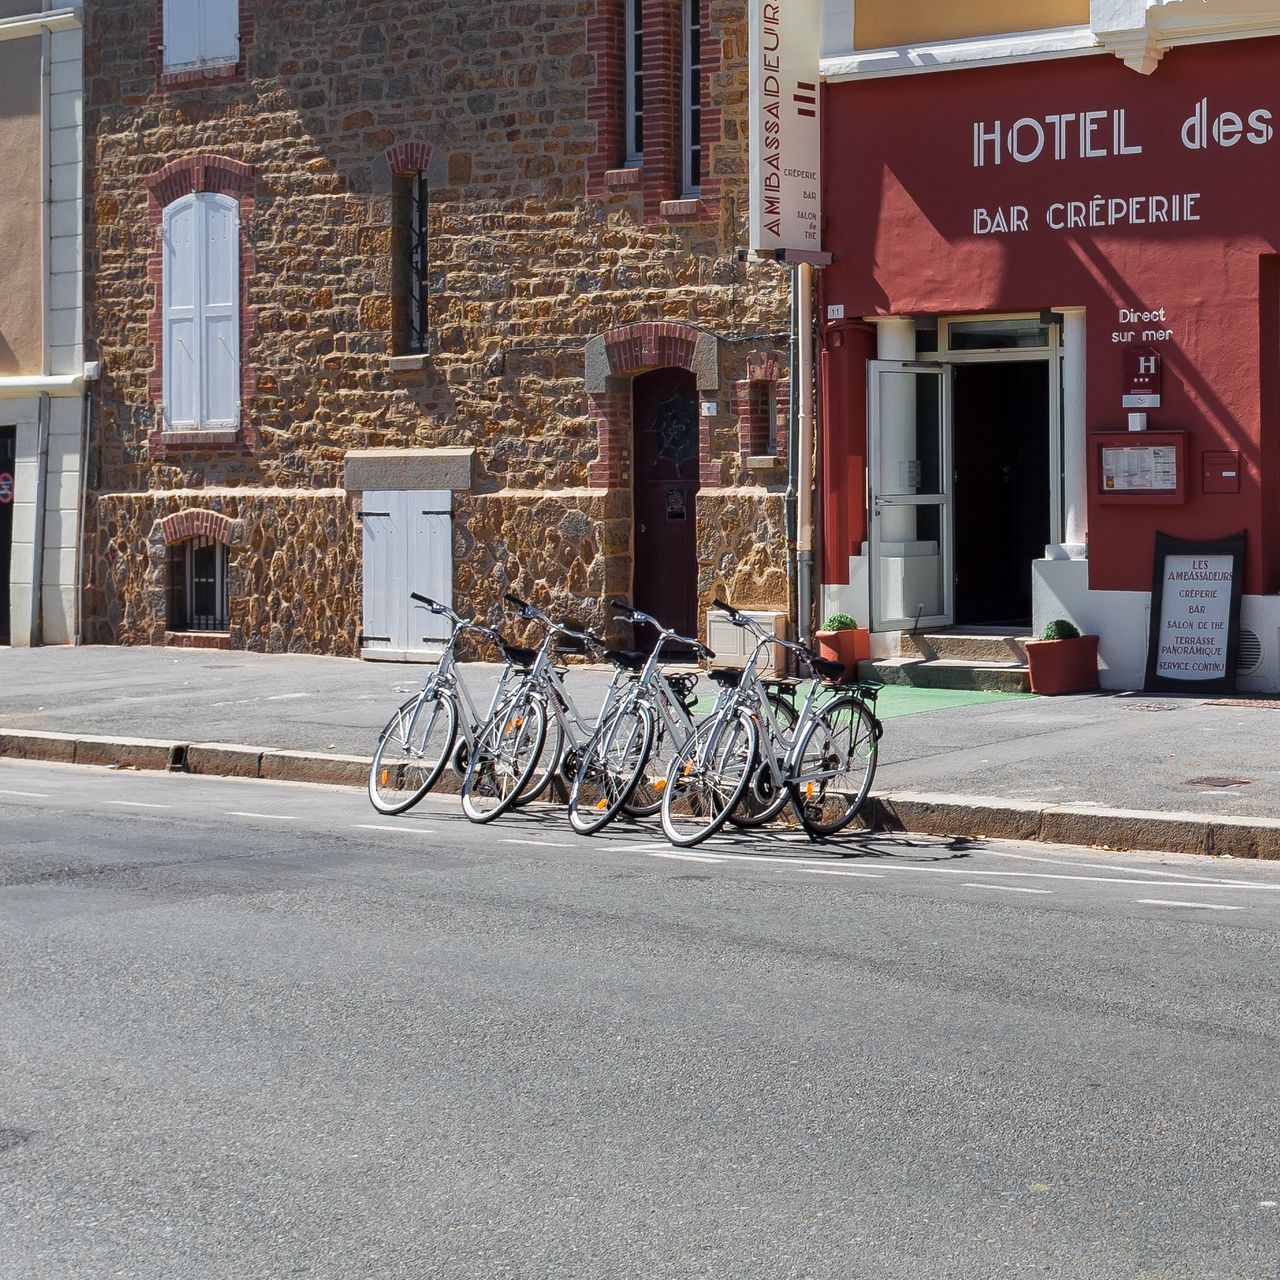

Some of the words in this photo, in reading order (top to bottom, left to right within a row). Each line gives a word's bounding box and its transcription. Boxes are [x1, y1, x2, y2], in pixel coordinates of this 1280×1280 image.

[973, 108, 1142, 167] HOTEL
[1181, 97, 1274, 150] des
[803, 191, 817, 200] BAR
[797, 210, 817, 221] SALON
[973, 205, 1029, 235] BAR
[1046, 193, 1201, 230] CRÊPERIE
[808, 222, 817, 231] de
[1118, 307, 1167, 323] Direct
[1111, 331, 1136, 343] sur
[1142, 328, 1174, 342] mer
[1138, 356, 1157, 374] H
[1192, 560, 1209, 570] LES
[1168, 571, 1233, 581] AMBASSADEURS
[1188, 604, 1206, 613] BAR
[1167, 620, 1194, 630] SALON
[1198, 621, 1208, 629] DE
[1174, 636, 1216, 645] TERRASSE
[1161, 645, 1223, 657] PANORAMIQUE
[1159, 661, 1190, 670] SERVICE
[1192, 661, 1225, 672] CONTINU
